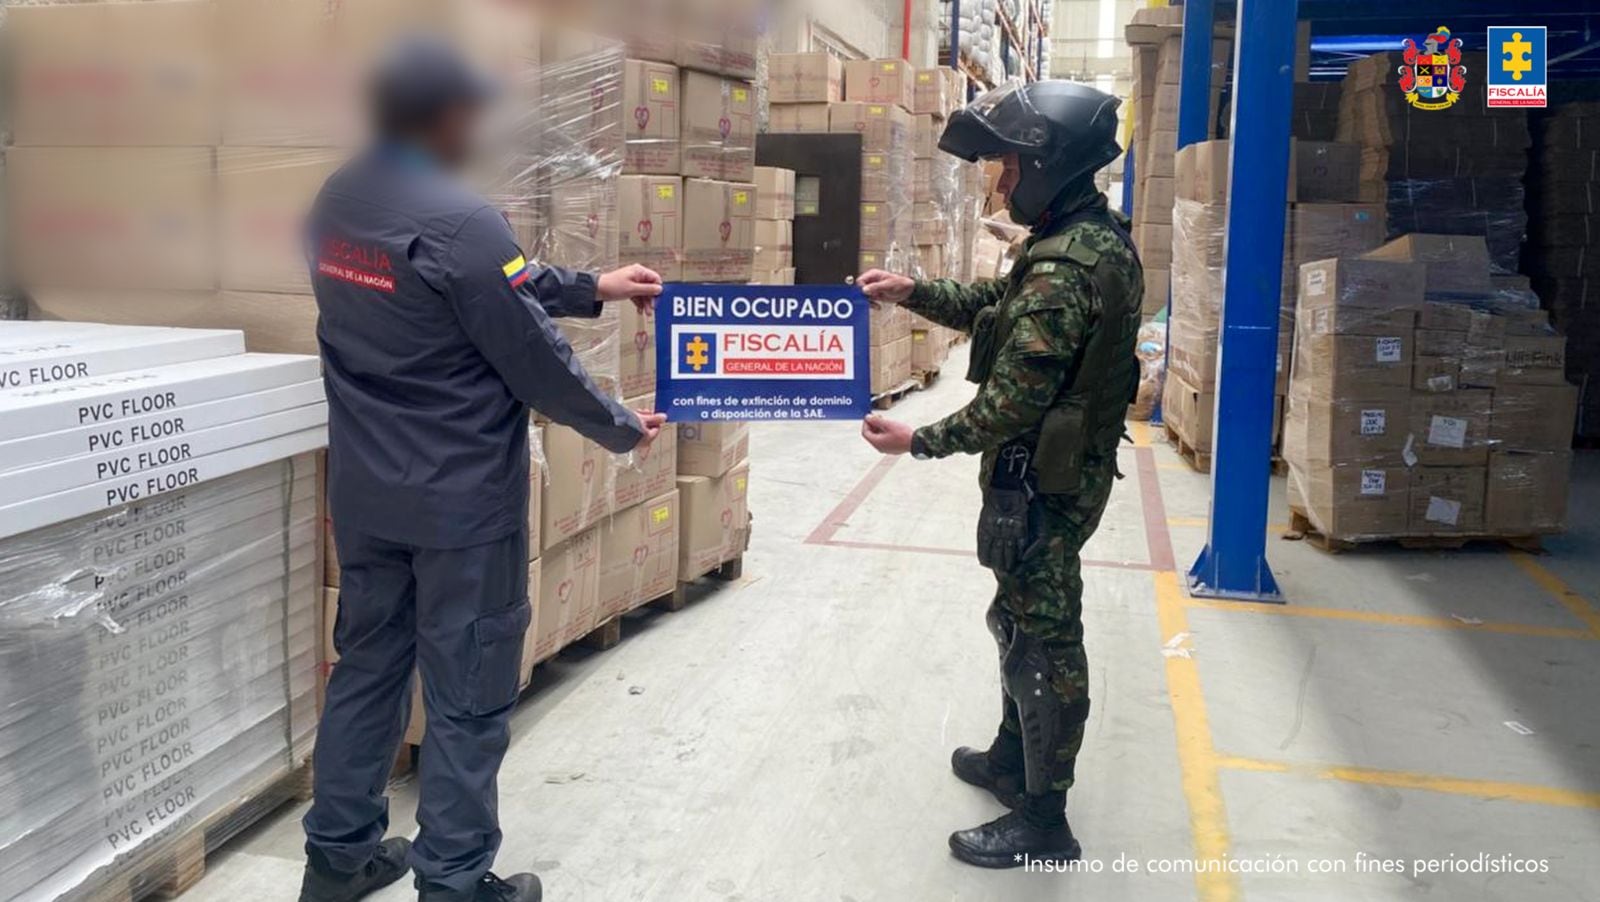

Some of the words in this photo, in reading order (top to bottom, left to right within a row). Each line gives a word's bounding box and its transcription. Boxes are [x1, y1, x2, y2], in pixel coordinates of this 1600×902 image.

[345, 269, 353, 281] DE
[354, 272, 363, 282] LA
[363, 274, 393, 289] NACIÓN
[673, 297, 723, 317] BIEN
[731, 297, 853, 318] OCUPADO
[724, 330, 843, 352] FISCALÍA
[0, 370, 20, 388] VC
[29, 362, 89, 384] FLOOR
[726, 362, 773, 372] GENERAL
[775, 362, 790, 372] DE
[792, 362, 804, 372] LA
[804, 361, 843, 372] NACIÓN
[79, 402, 114, 424] PVC
[122, 392, 177, 416] FLOOR
[673, 398, 694, 406] con
[696, 395, 721, 406] fines
[724, 396, 739, 406] de
[793, 396, 807, 406] de
[810, 395, 853, 406] dominio
[700, 410, 708, 418] a
[711, 408, 772, 420] disposición
[774, 409, 788, 419] de
[790, 409, 801, 419] la
[803, 409, 826, 418] SAE.
[88, 430, 123, 452] PVC
[131, 417, 185, 443] FLOOR
[97, 457, 131, 479] PVC
[139, 443, 192, 469] FLOOR
[106, 483, 140, 505] PVC
[147, 468, 199, 494] FLOOR
[94, 538, 127, 562] PVC
[134, 520, 186, 549] FLOOR
[134, 546, 186, 575] FLOOR
[97, 700, 130, 726] PVC
[97, 725, 129, 754] PVC
[136, 697, 187, 734] FLOOR
[101, 747, 133, 778] PVC
[140, 717, 190, 756] FLOOR
[103, 774, 136, 805] PVC
[141, 742, 195, 782] FLOOR
[107, 820, 143, 849] PVC
[145, 785, 196, 826] FLOOR
